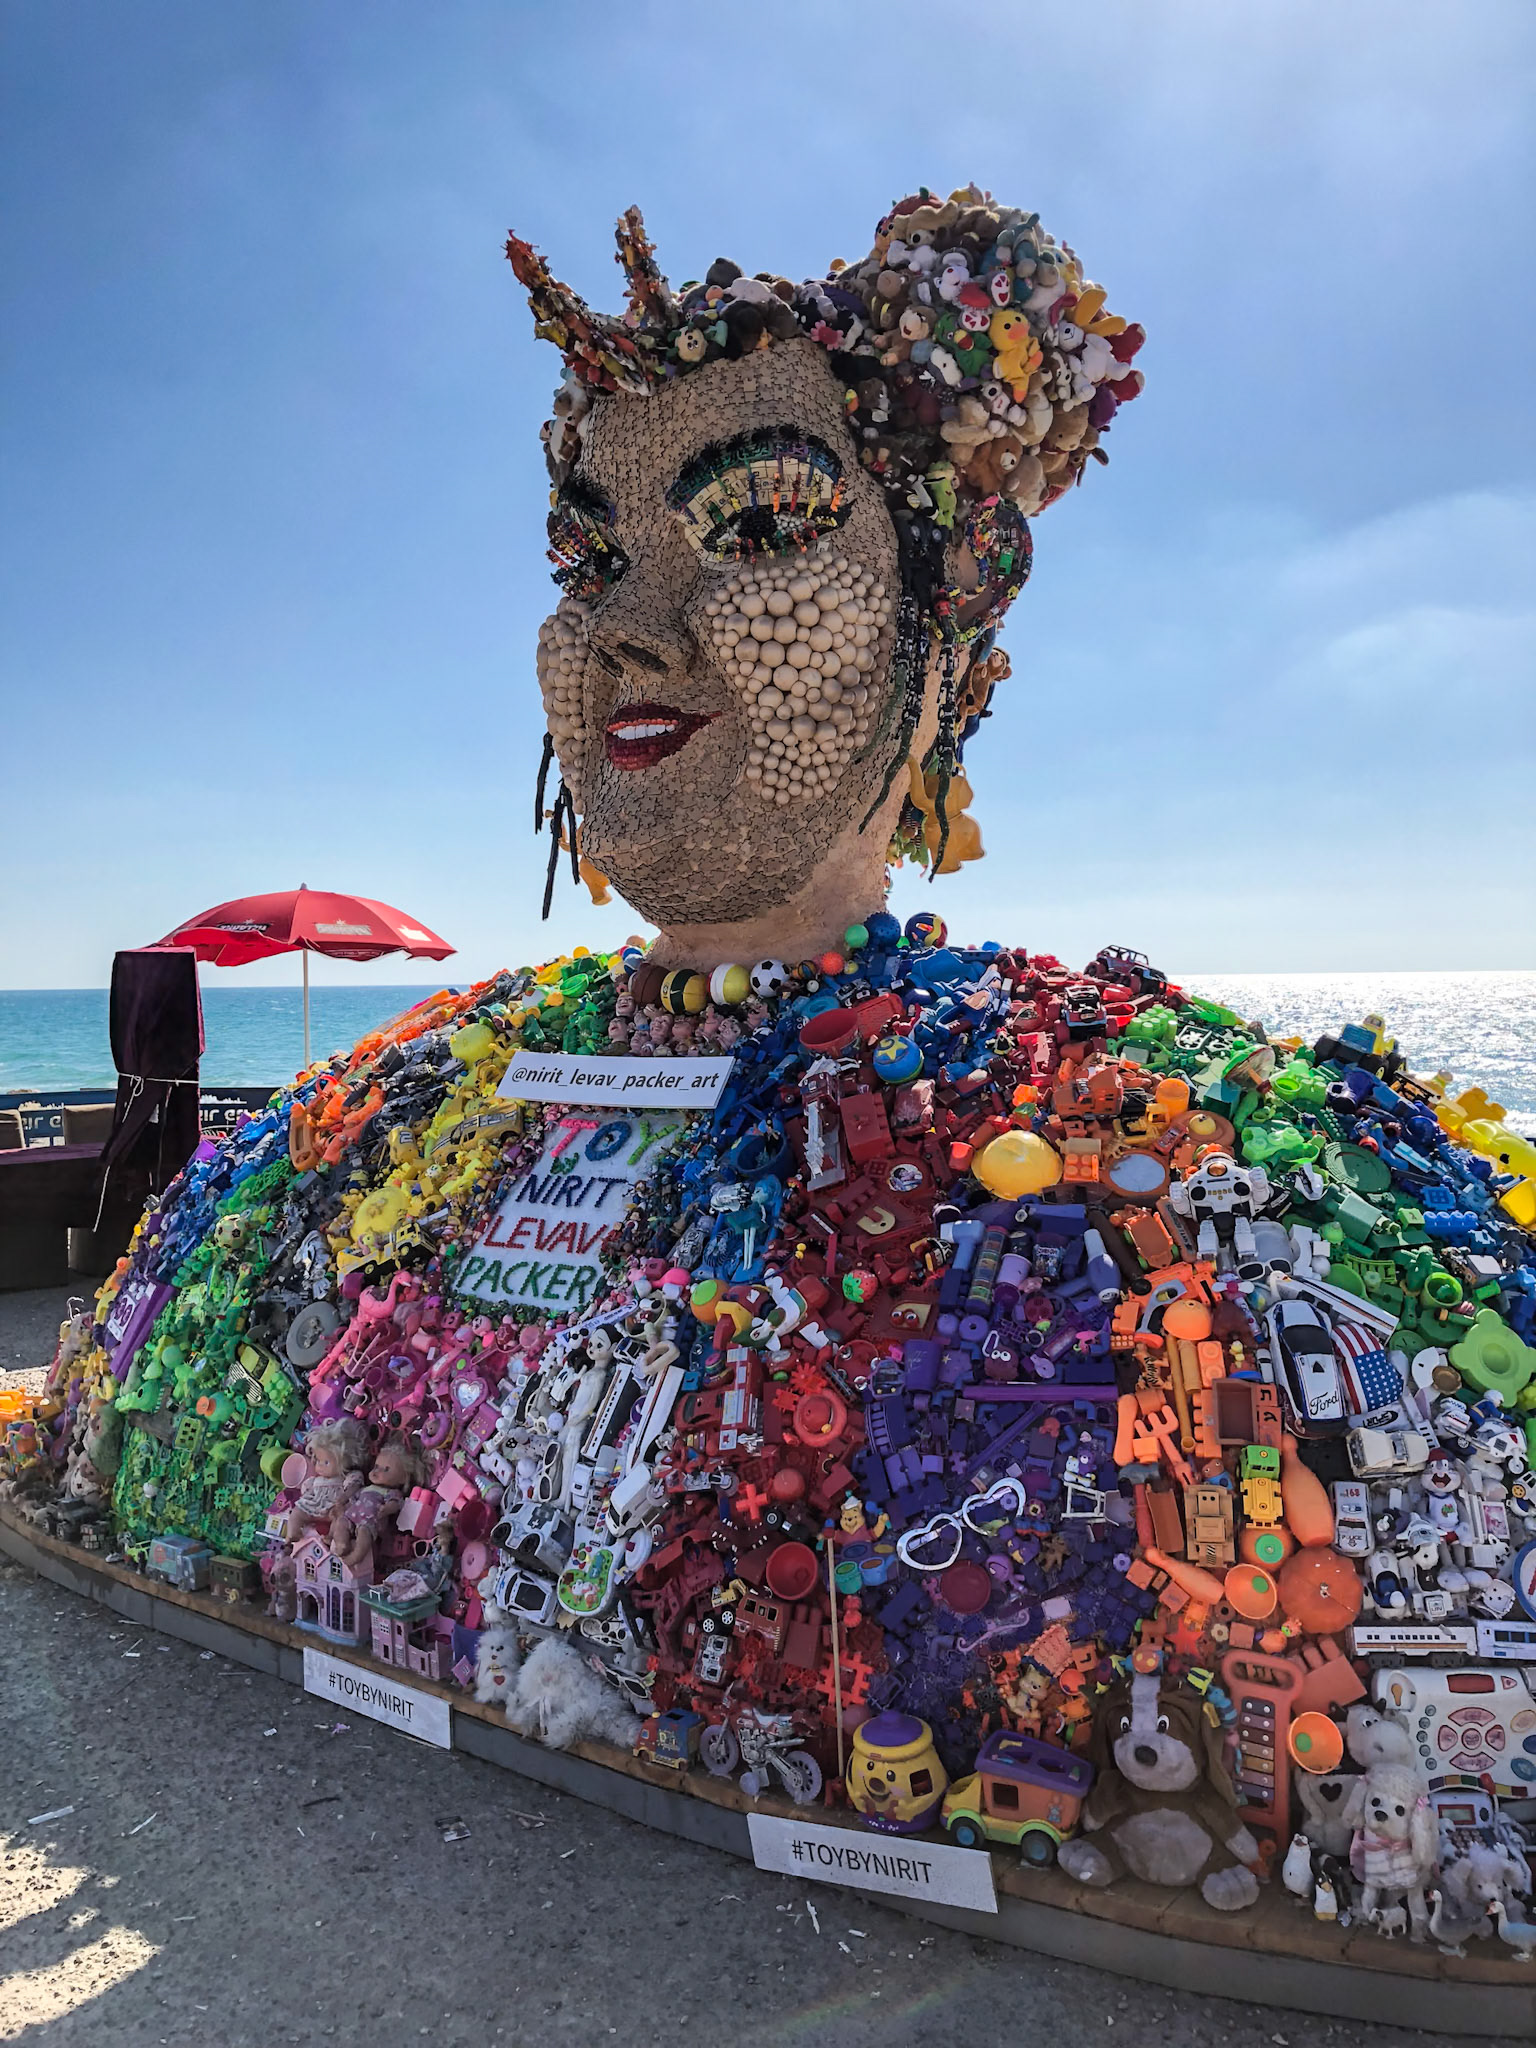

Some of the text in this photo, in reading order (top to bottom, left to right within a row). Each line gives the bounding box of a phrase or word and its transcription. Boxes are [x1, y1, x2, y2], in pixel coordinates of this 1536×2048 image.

[511, 1066, 719, 1091] @nirit_levav_packer_art
[550, 1117, 679, 1166] TOY
[515, 1173, 628, 1208] NIRIT
[483, 1215, 609, 1255] LEVAV
[455, 1255, 598, 1304] PACKER
[1310, 1391, 1340, 1416] Ford
[329, 1670, 415, 1720] #TOYBYNIRIT
[792, 1839, 932, 1884] #TOYBYNIRIT
